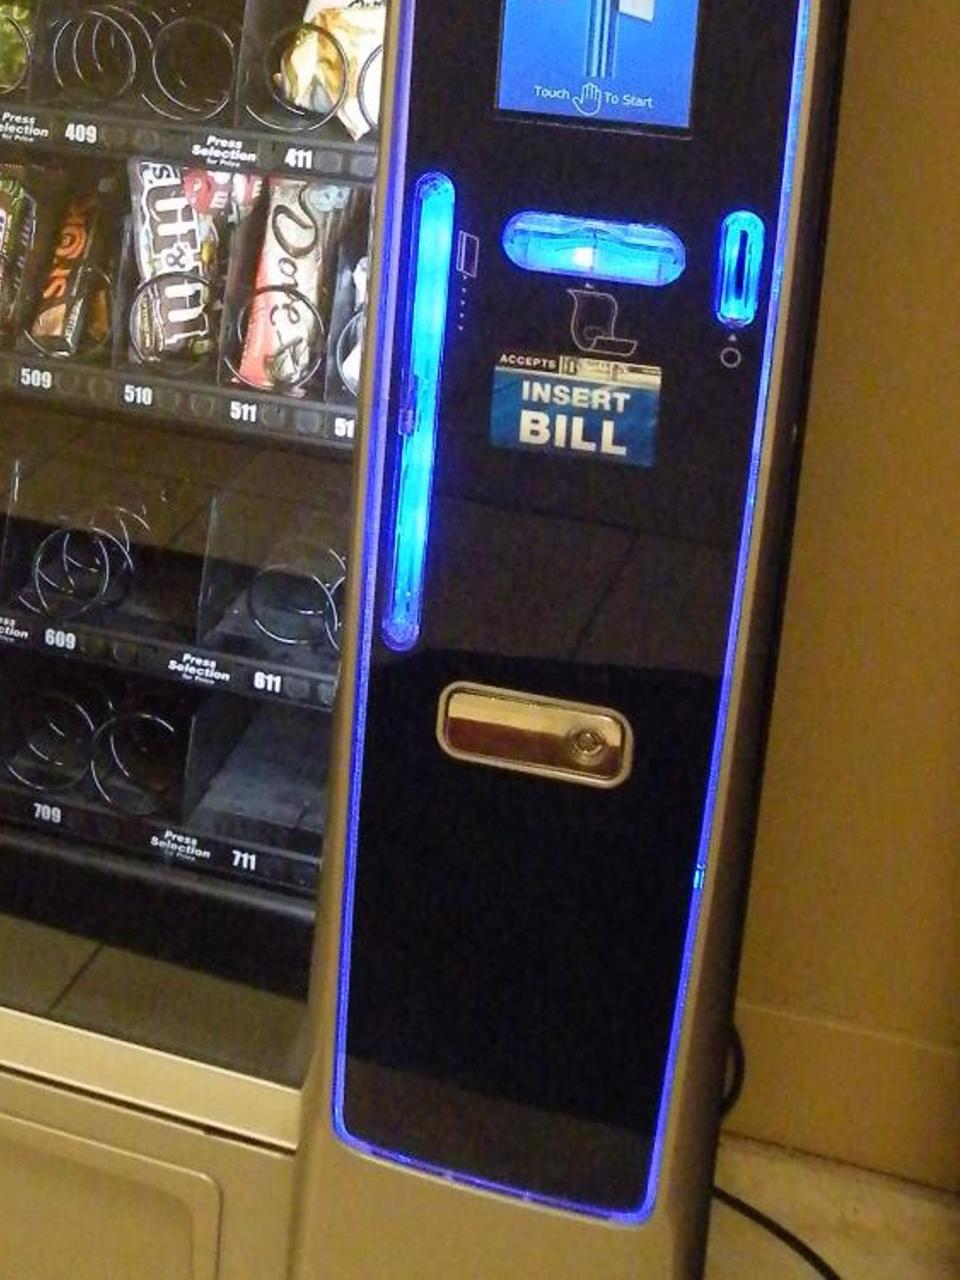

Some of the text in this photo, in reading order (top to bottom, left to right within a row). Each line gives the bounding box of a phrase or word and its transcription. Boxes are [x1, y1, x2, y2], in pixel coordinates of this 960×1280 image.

[533, 84, 654, 109] Touch To Start
[1, 111, 37, 125] Press
[65, 123, 98, 144] 409
[205, 134, 244, 150] Press
[191, 144, 256, 163] Selection
[284, 148, 312, 169] 411
[499, 352, 557, 370] ACCEPTS
[20, 367, 53, 389] 509
[123, 384, 153, 405] 510
[521, 379, 632, 414] INSERT
[229, 401, 258, 422] 511
[518, 408, 628, 458] BILL
[44, 628, 77, 650] 609
[167, 658, 231, 682] Selection
[182, 652, 218, 669] Press
[253, 671, 282, 693] 611
[32, 802, 63, 824] 709
[150, 835, 212, 860] Selection
[163, 829, 200, 847] Press
[231, 849, 257, 872] 711
